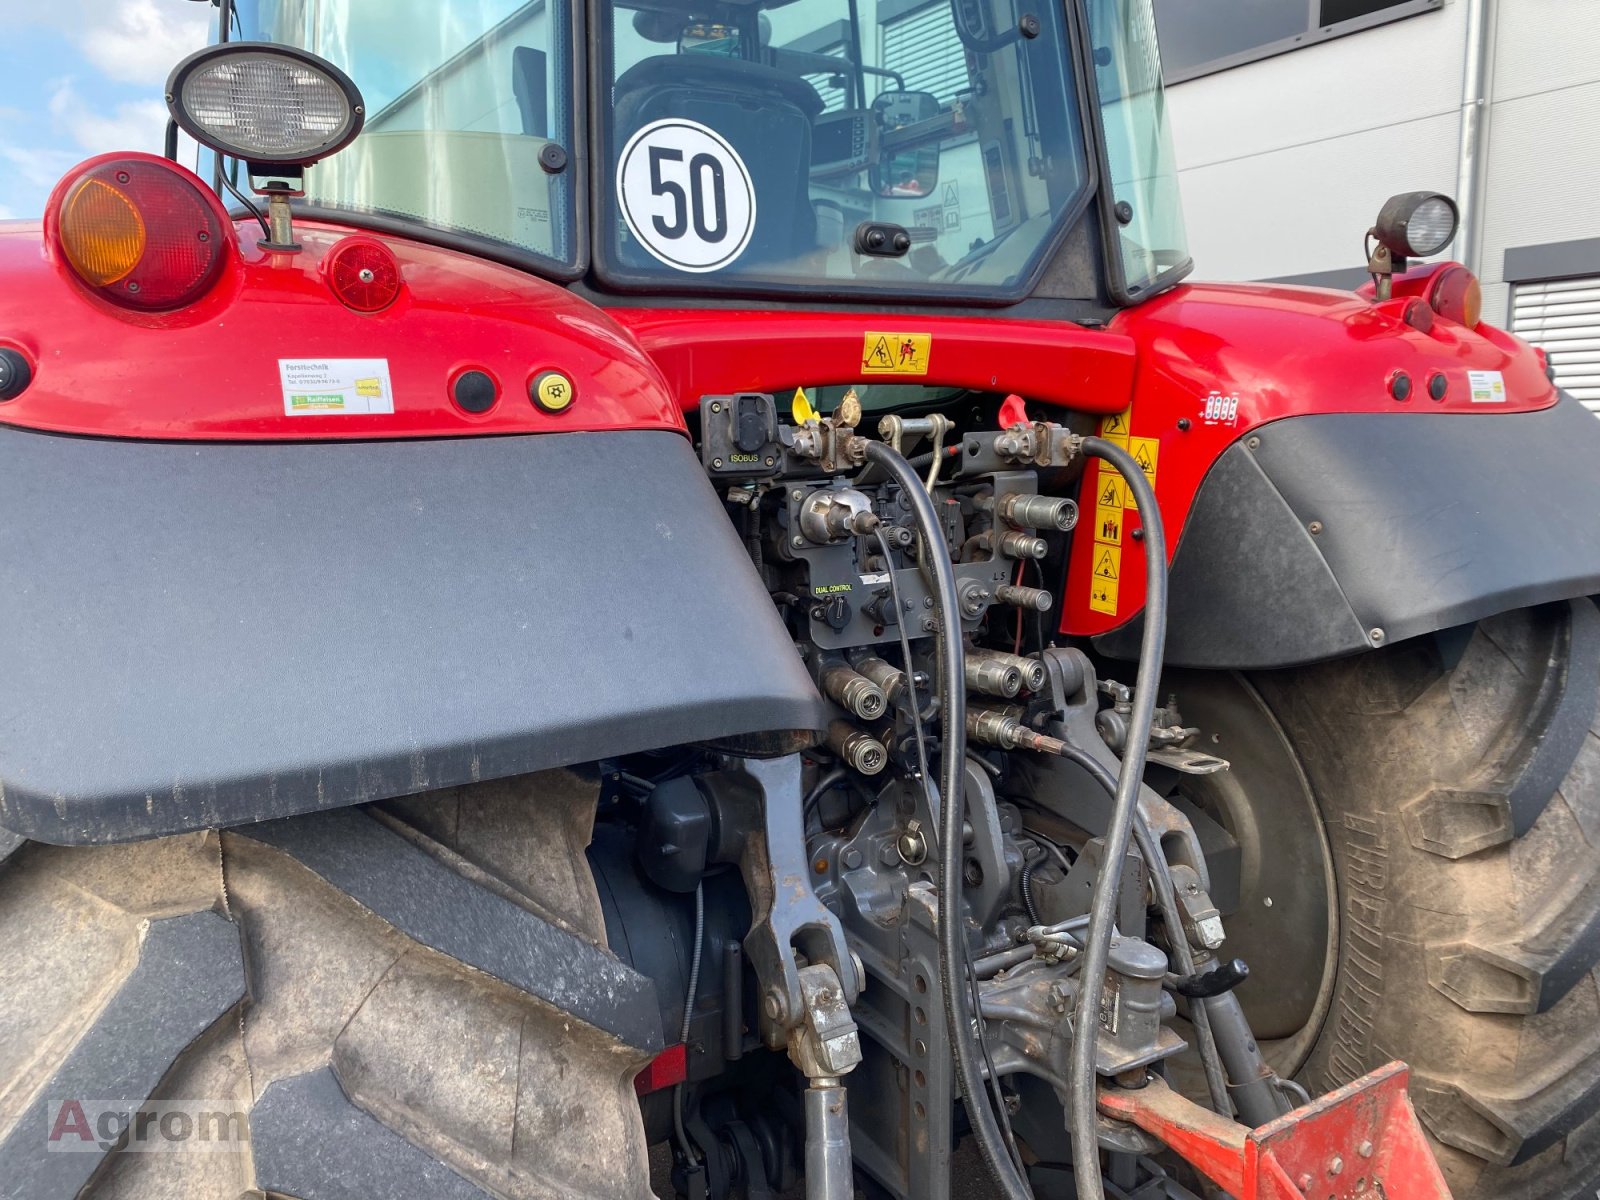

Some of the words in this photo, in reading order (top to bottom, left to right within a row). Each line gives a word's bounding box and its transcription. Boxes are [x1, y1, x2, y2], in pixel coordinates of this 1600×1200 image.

[648, 145, 728, 244] 50
[730, 454, 759, 462] ISOBUS
[815, 586, 829, 594] DUAL
[829, 584, 852, 592] CONTROL
